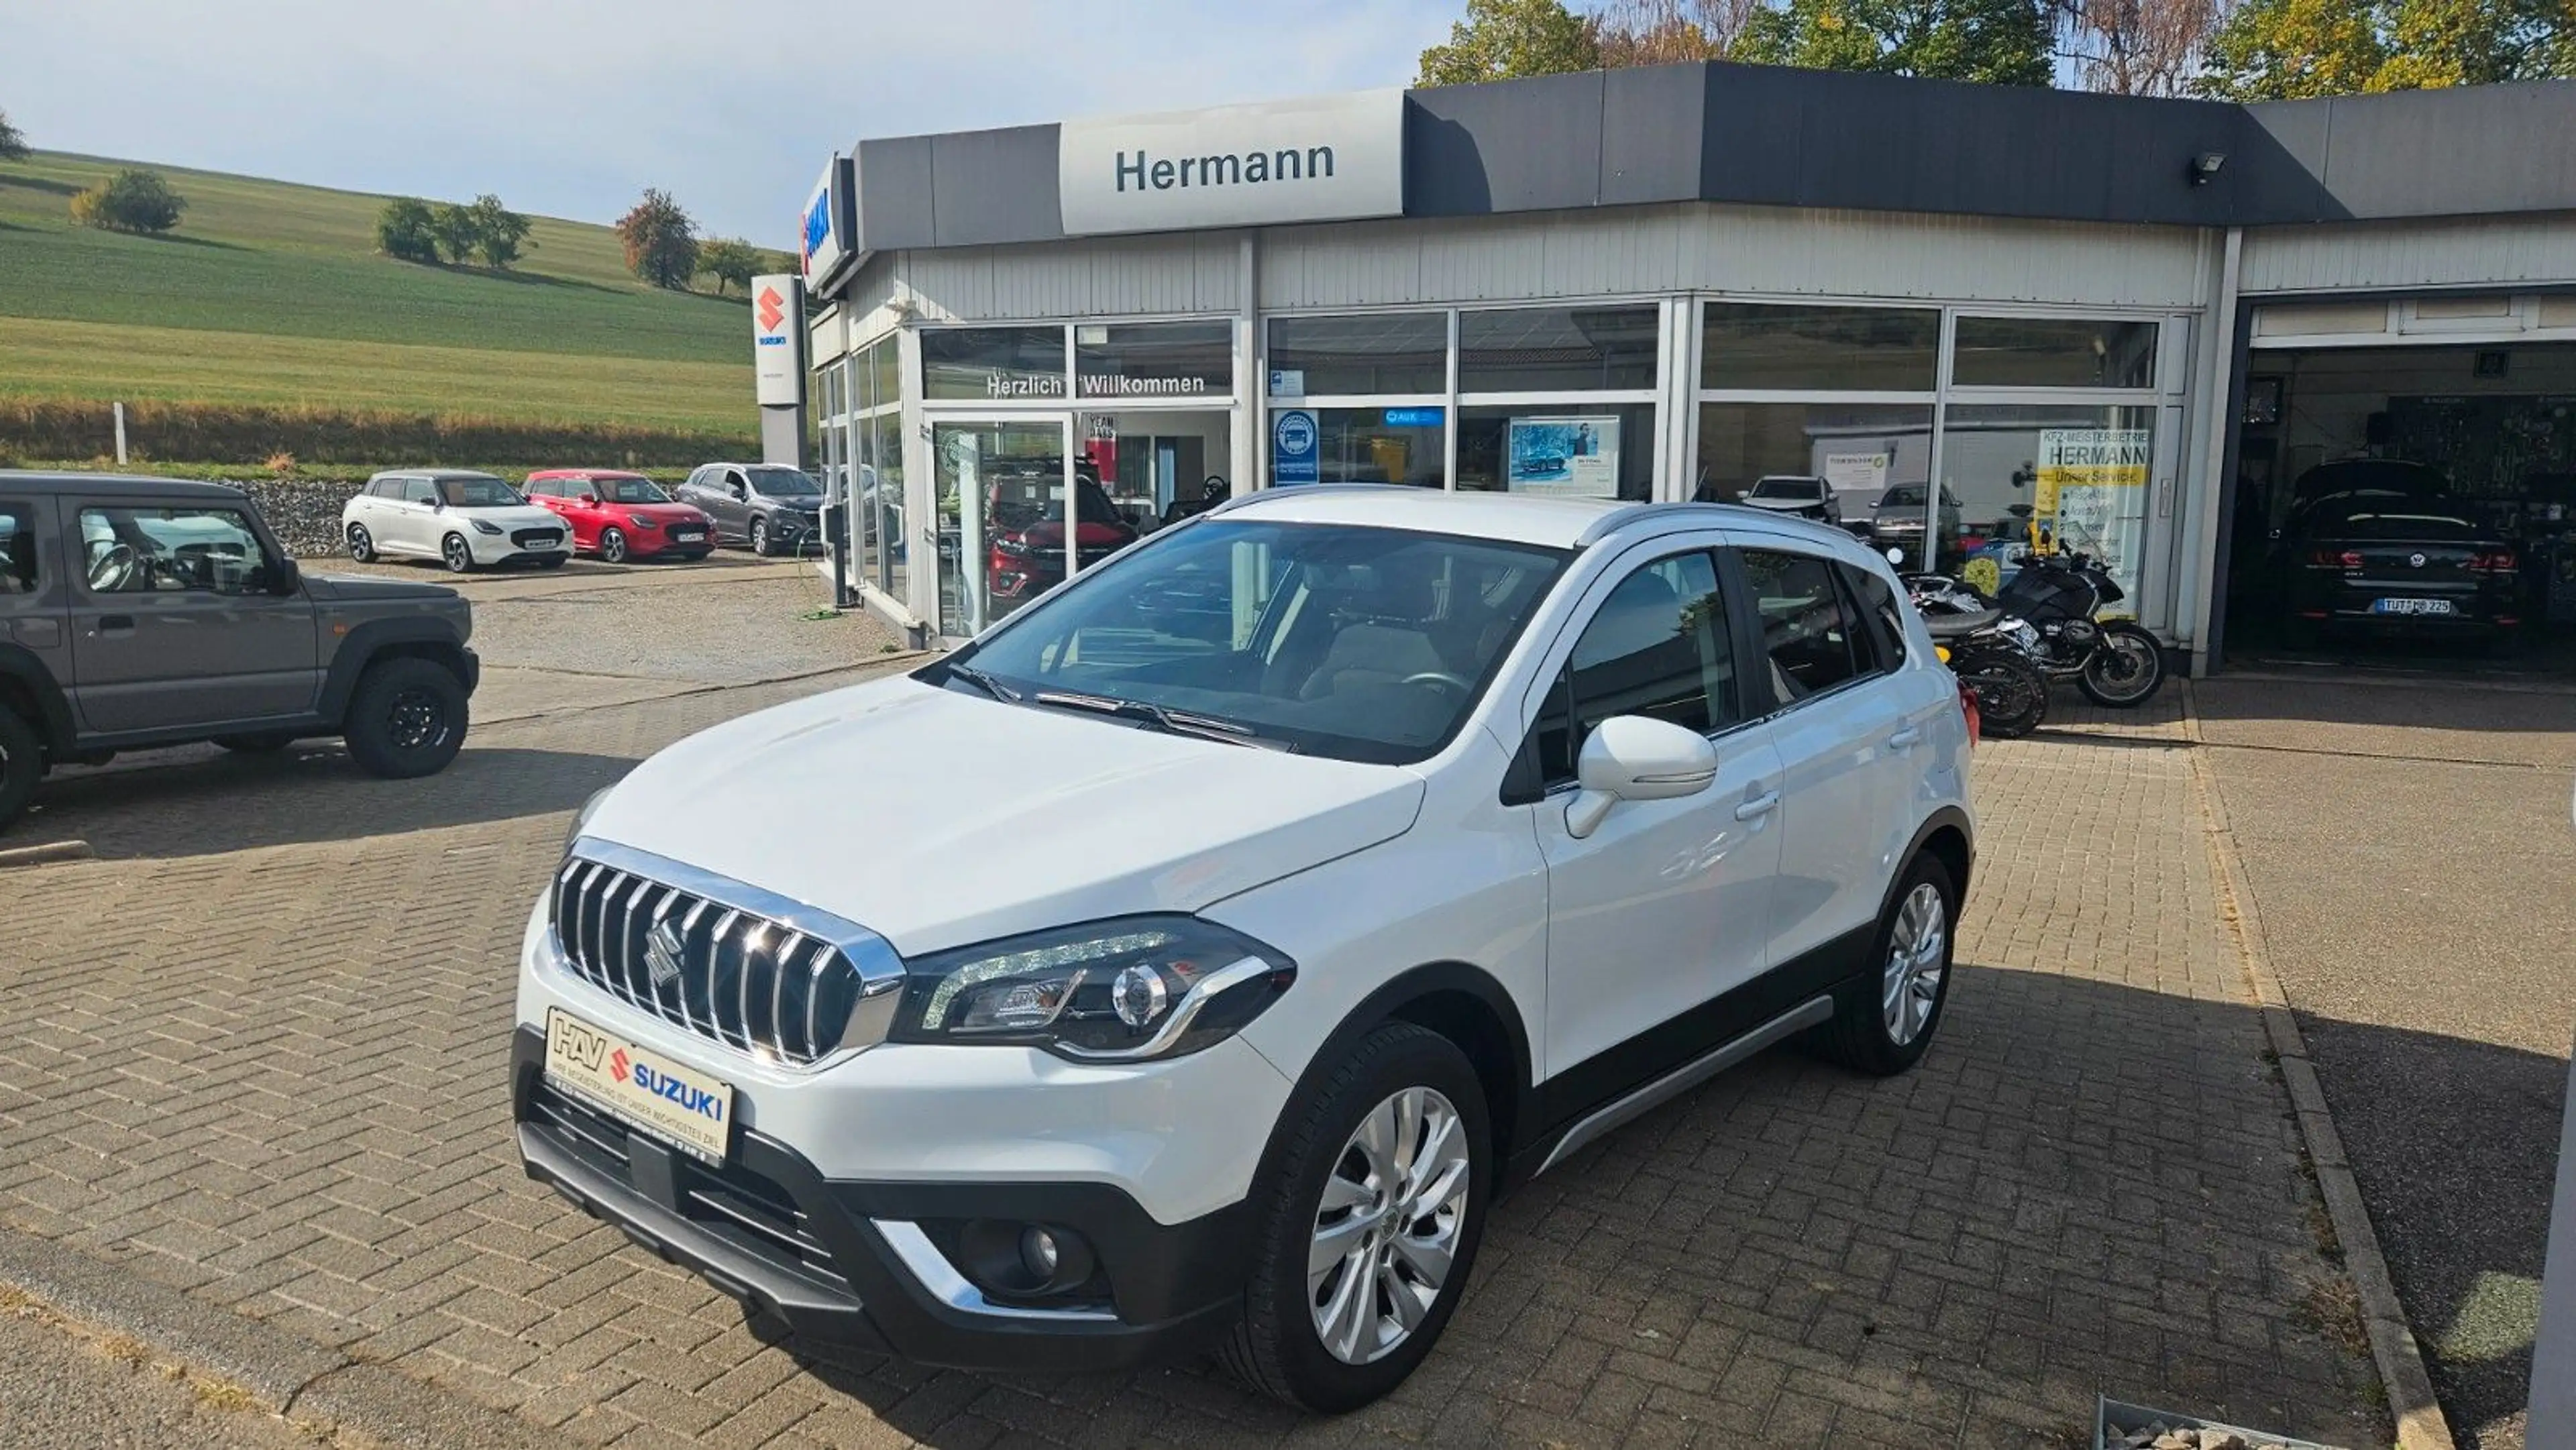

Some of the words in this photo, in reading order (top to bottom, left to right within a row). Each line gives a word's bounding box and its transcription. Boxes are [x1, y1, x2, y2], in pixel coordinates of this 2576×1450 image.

[1116, 146, 1334, 192] Hermann
[987, 376, 1061, 394] Herzlich
[1084, 376, 1205, 394] Willkommen
[2049, 446, 2146, 464] HERMANN
[2055, 471, 2088, 483] Unser
[553, 1017, 606, 1072] HAV
[634, 1063, 722, 1121] SUZUKI
